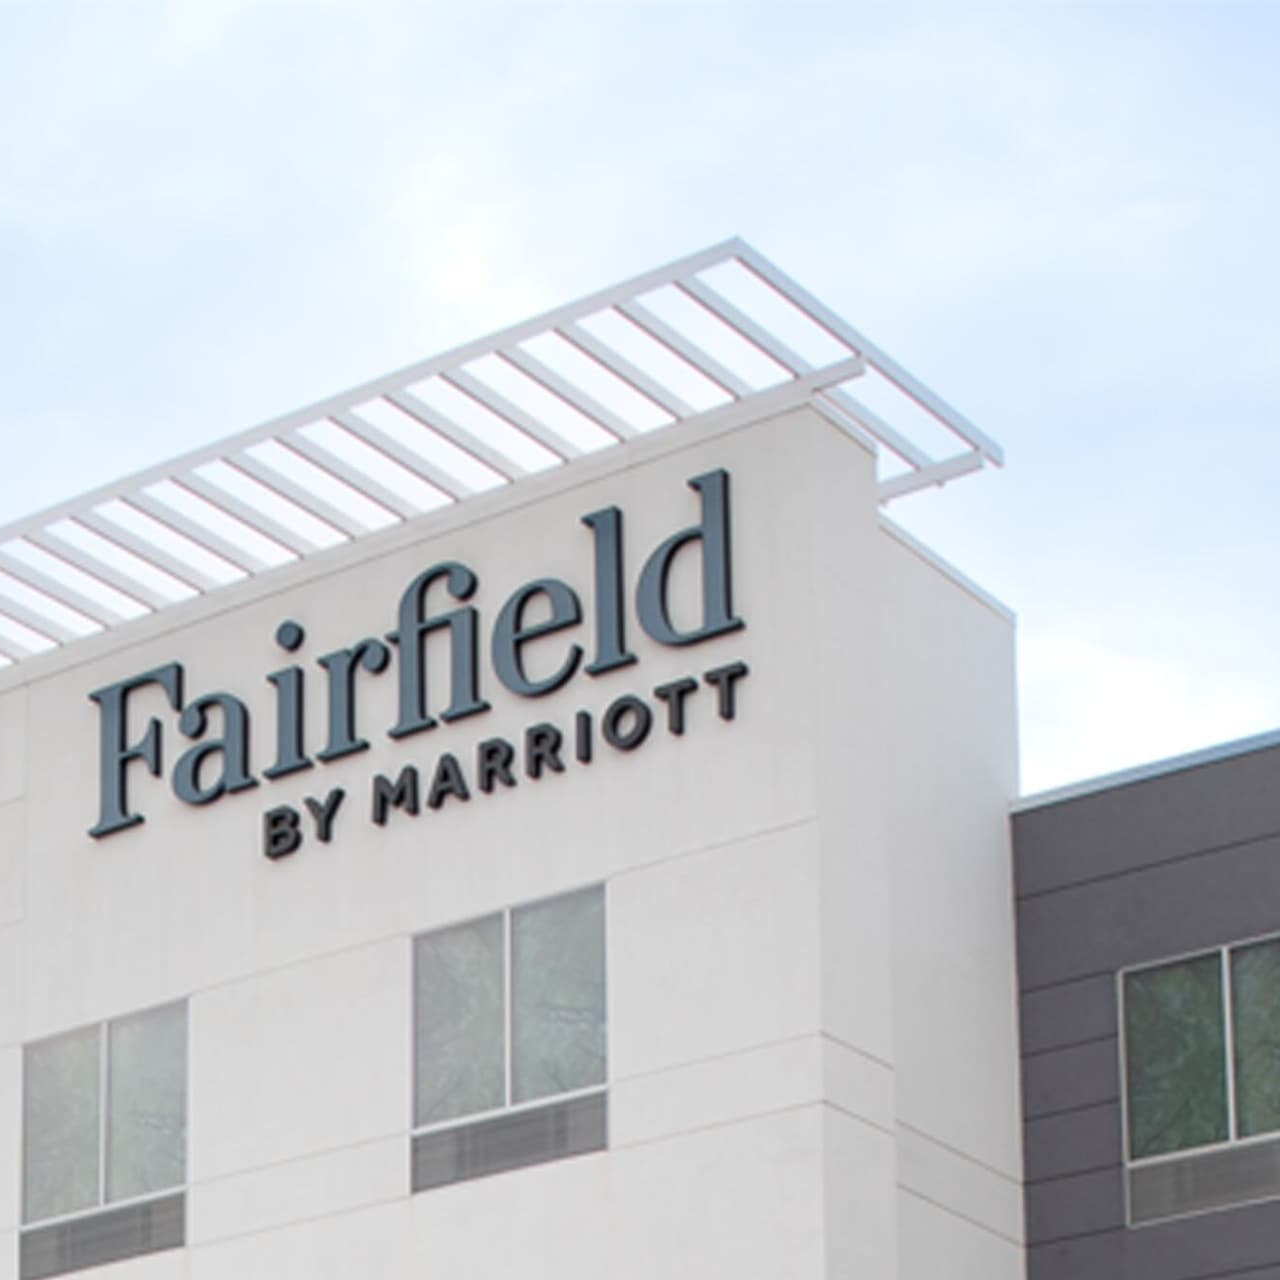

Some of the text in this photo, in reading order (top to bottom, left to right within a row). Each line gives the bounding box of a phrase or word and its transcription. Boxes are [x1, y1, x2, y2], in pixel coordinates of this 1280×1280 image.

[88, 467, 746, 840] Fairfield
[262, 660, 750, 859] BY MARRIOTT
